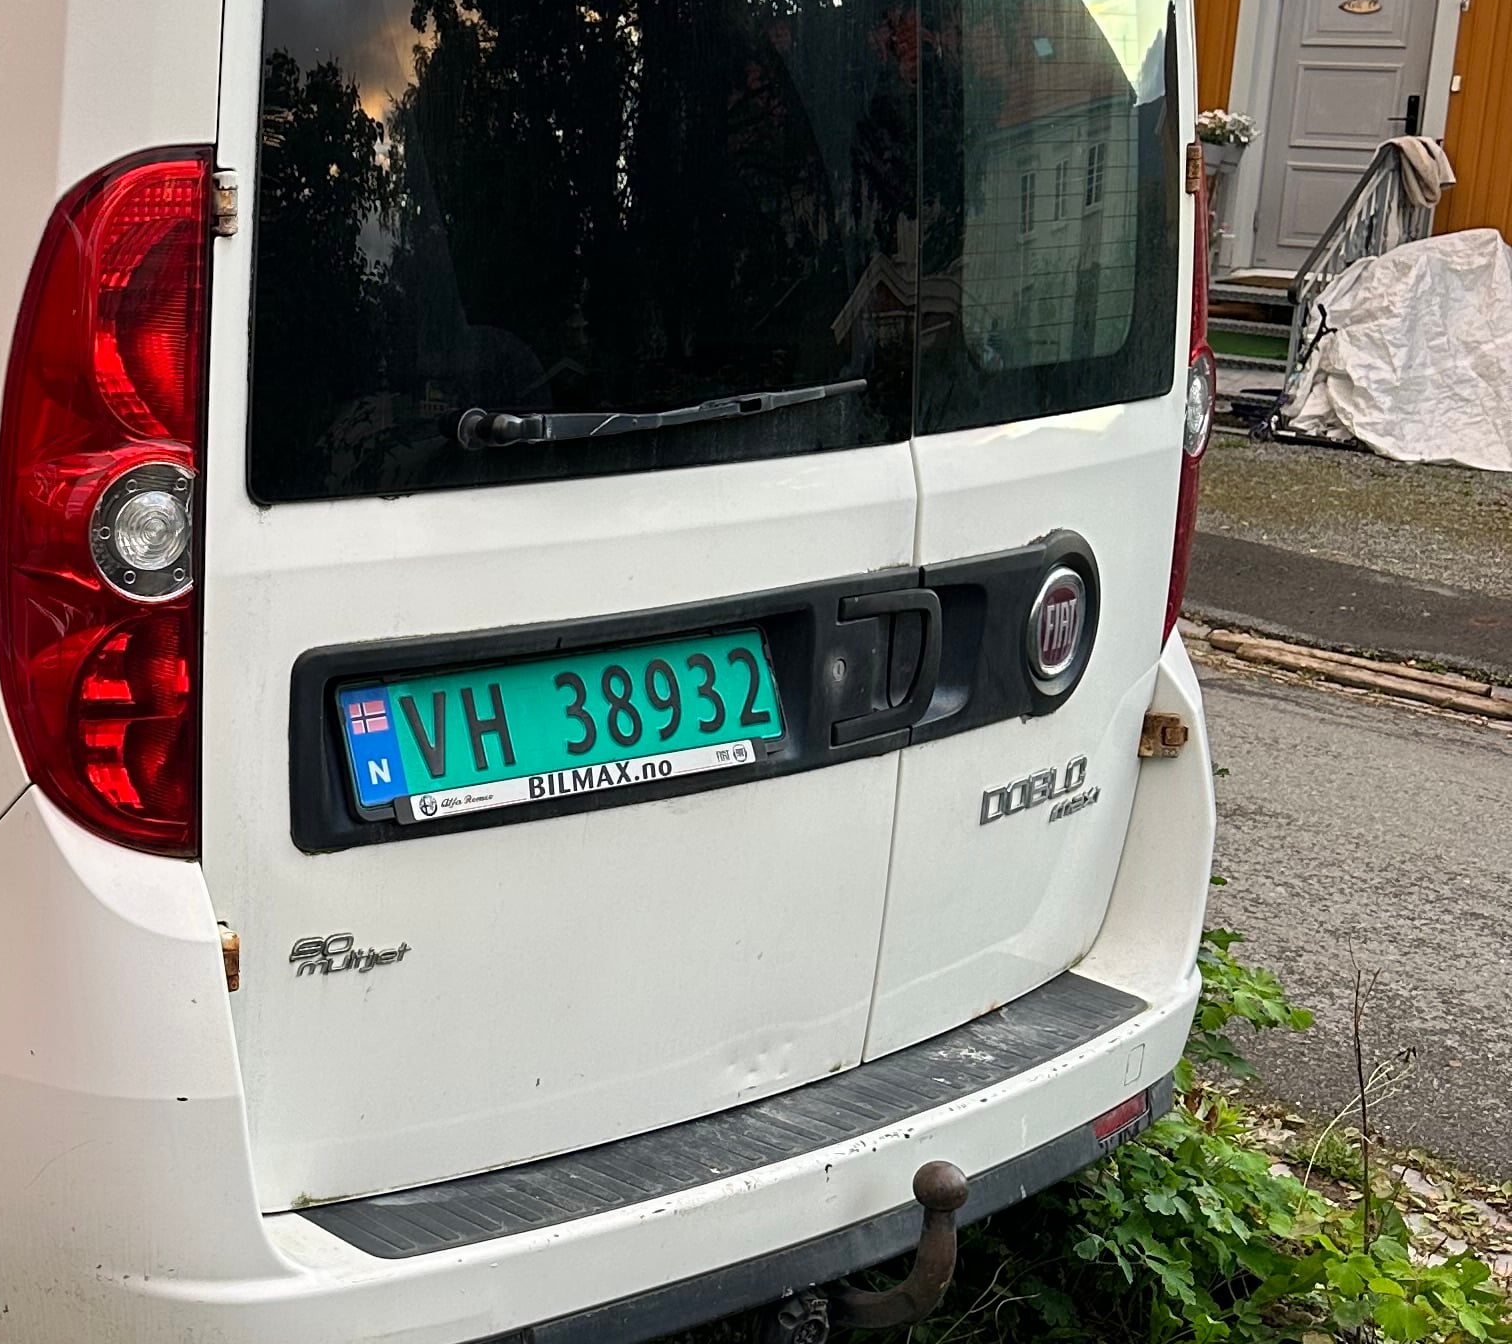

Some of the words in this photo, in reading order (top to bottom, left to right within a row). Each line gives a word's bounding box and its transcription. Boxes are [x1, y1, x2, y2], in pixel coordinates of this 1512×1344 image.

[1042, 598, 1078, 652] FIAT
[399, 683, 516, 777] VH
[554, 647, 771, 755] 38932
[368, 759, 391, 785] N
[528, 759, 673, 800] BILMAX.no
